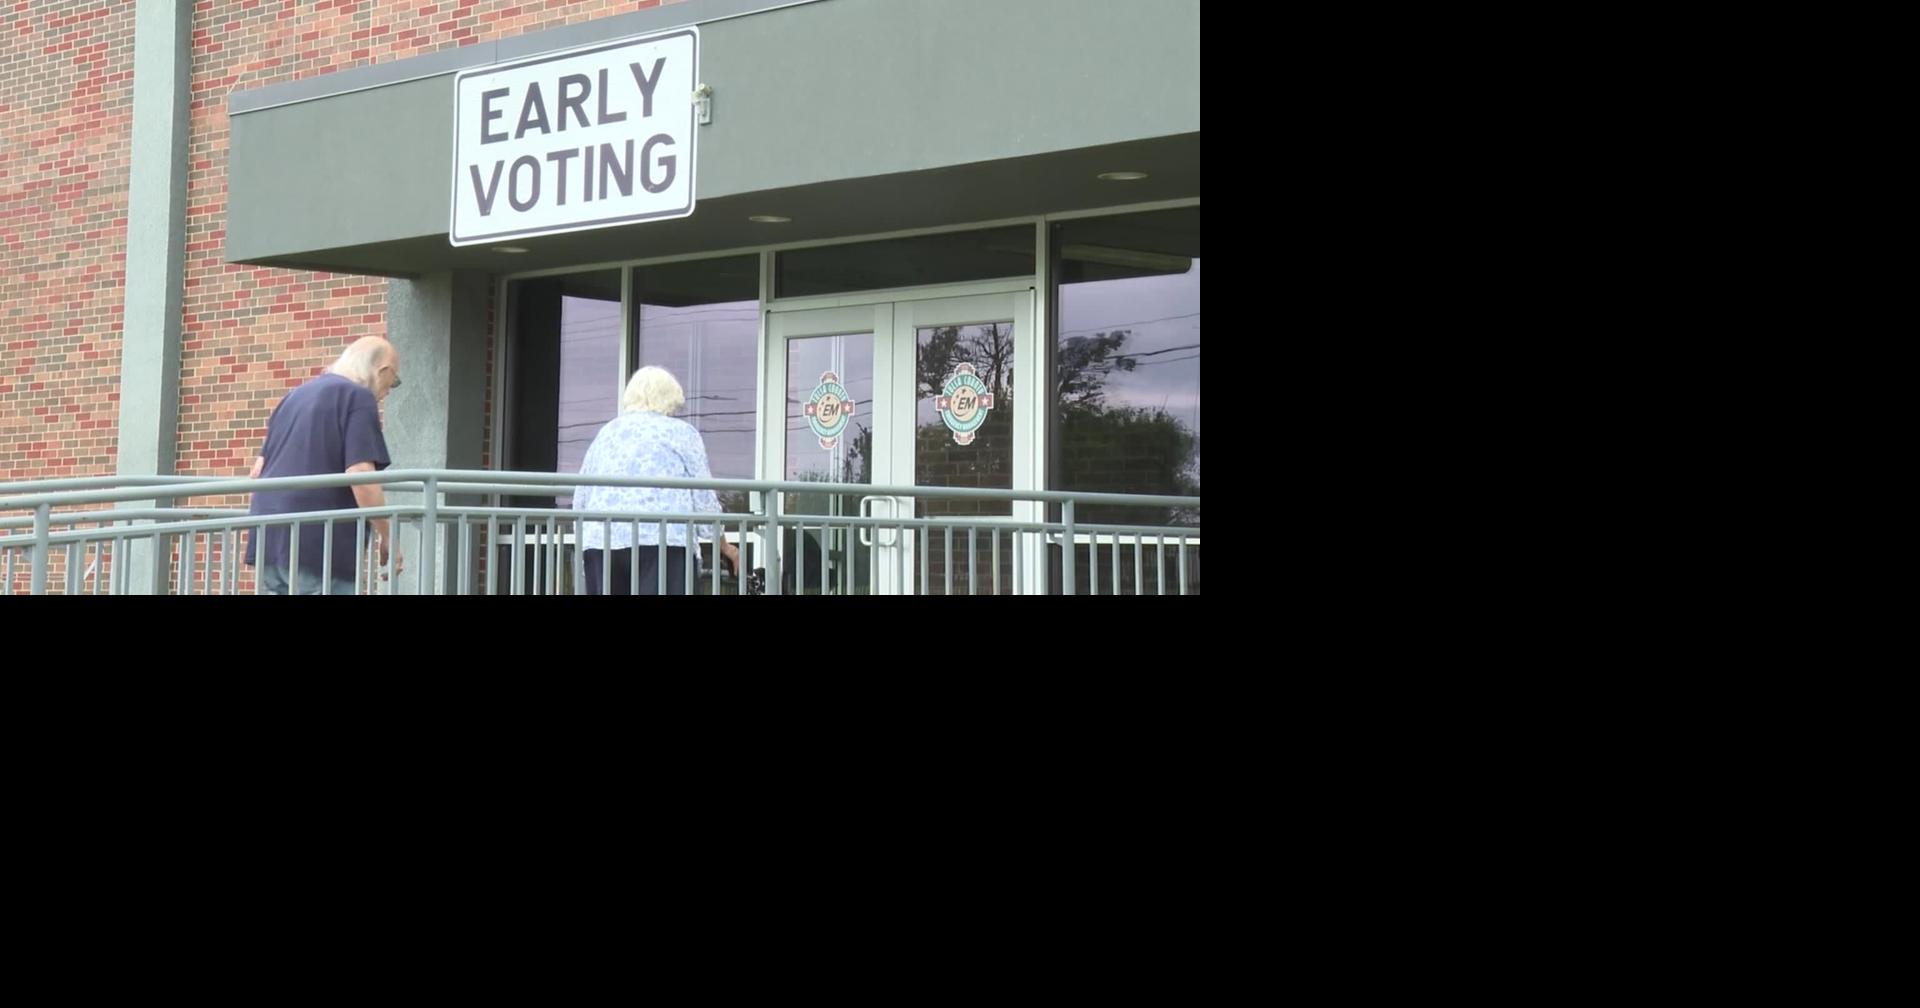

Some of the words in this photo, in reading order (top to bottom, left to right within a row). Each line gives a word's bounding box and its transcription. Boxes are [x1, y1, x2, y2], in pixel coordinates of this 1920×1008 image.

[480, 57, 667, 145] EARLY
[469, 133, 677, 217] VOTING
[823, 404, 839, 416] EM
[957, 397, 976, 410] EM
